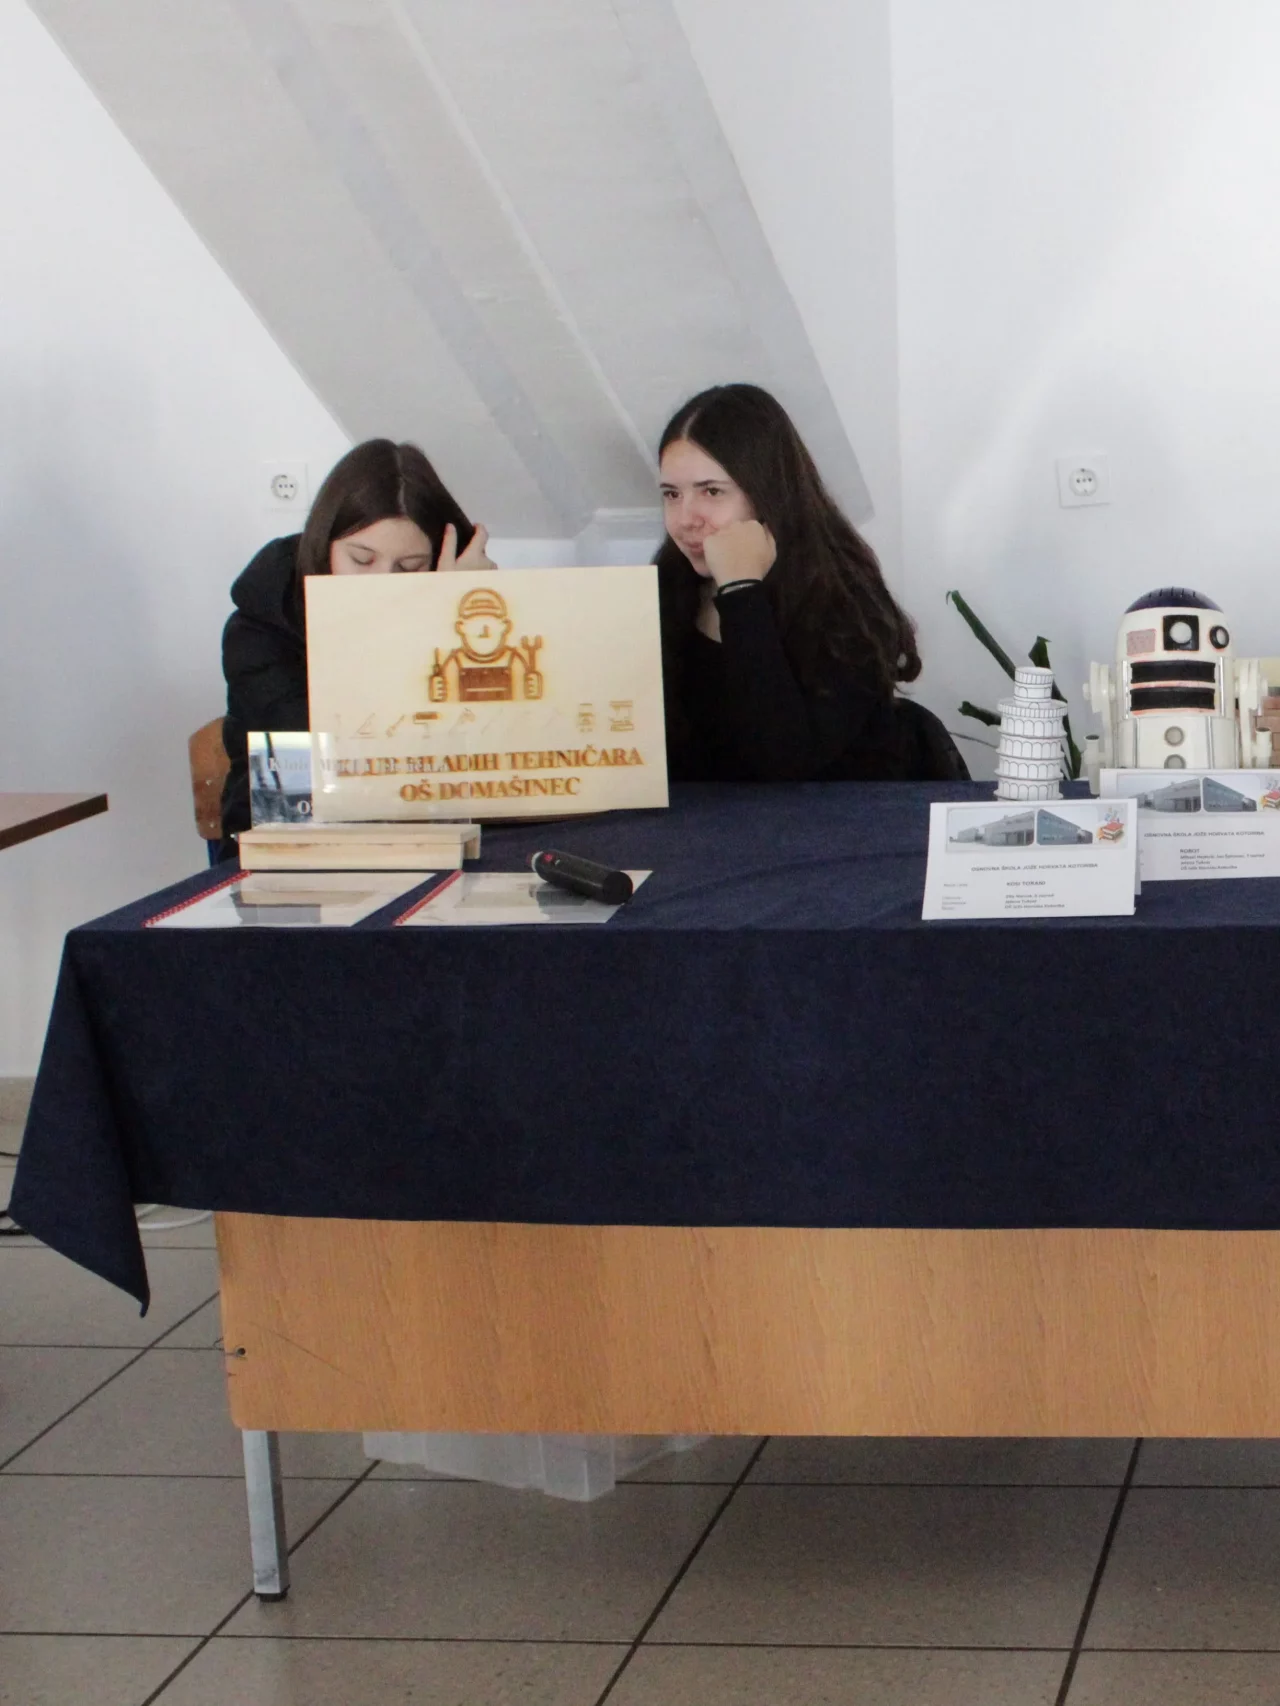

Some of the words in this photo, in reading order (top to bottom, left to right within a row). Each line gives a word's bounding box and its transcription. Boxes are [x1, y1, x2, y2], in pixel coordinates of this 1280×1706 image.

[405, 753, 500, 774] MLADIH
[505, 745, 645, 771] TEHNIČARA
[399, 778, 433, 801] OŠ
[438, 774, 582, 801] DOMAŠINEC
